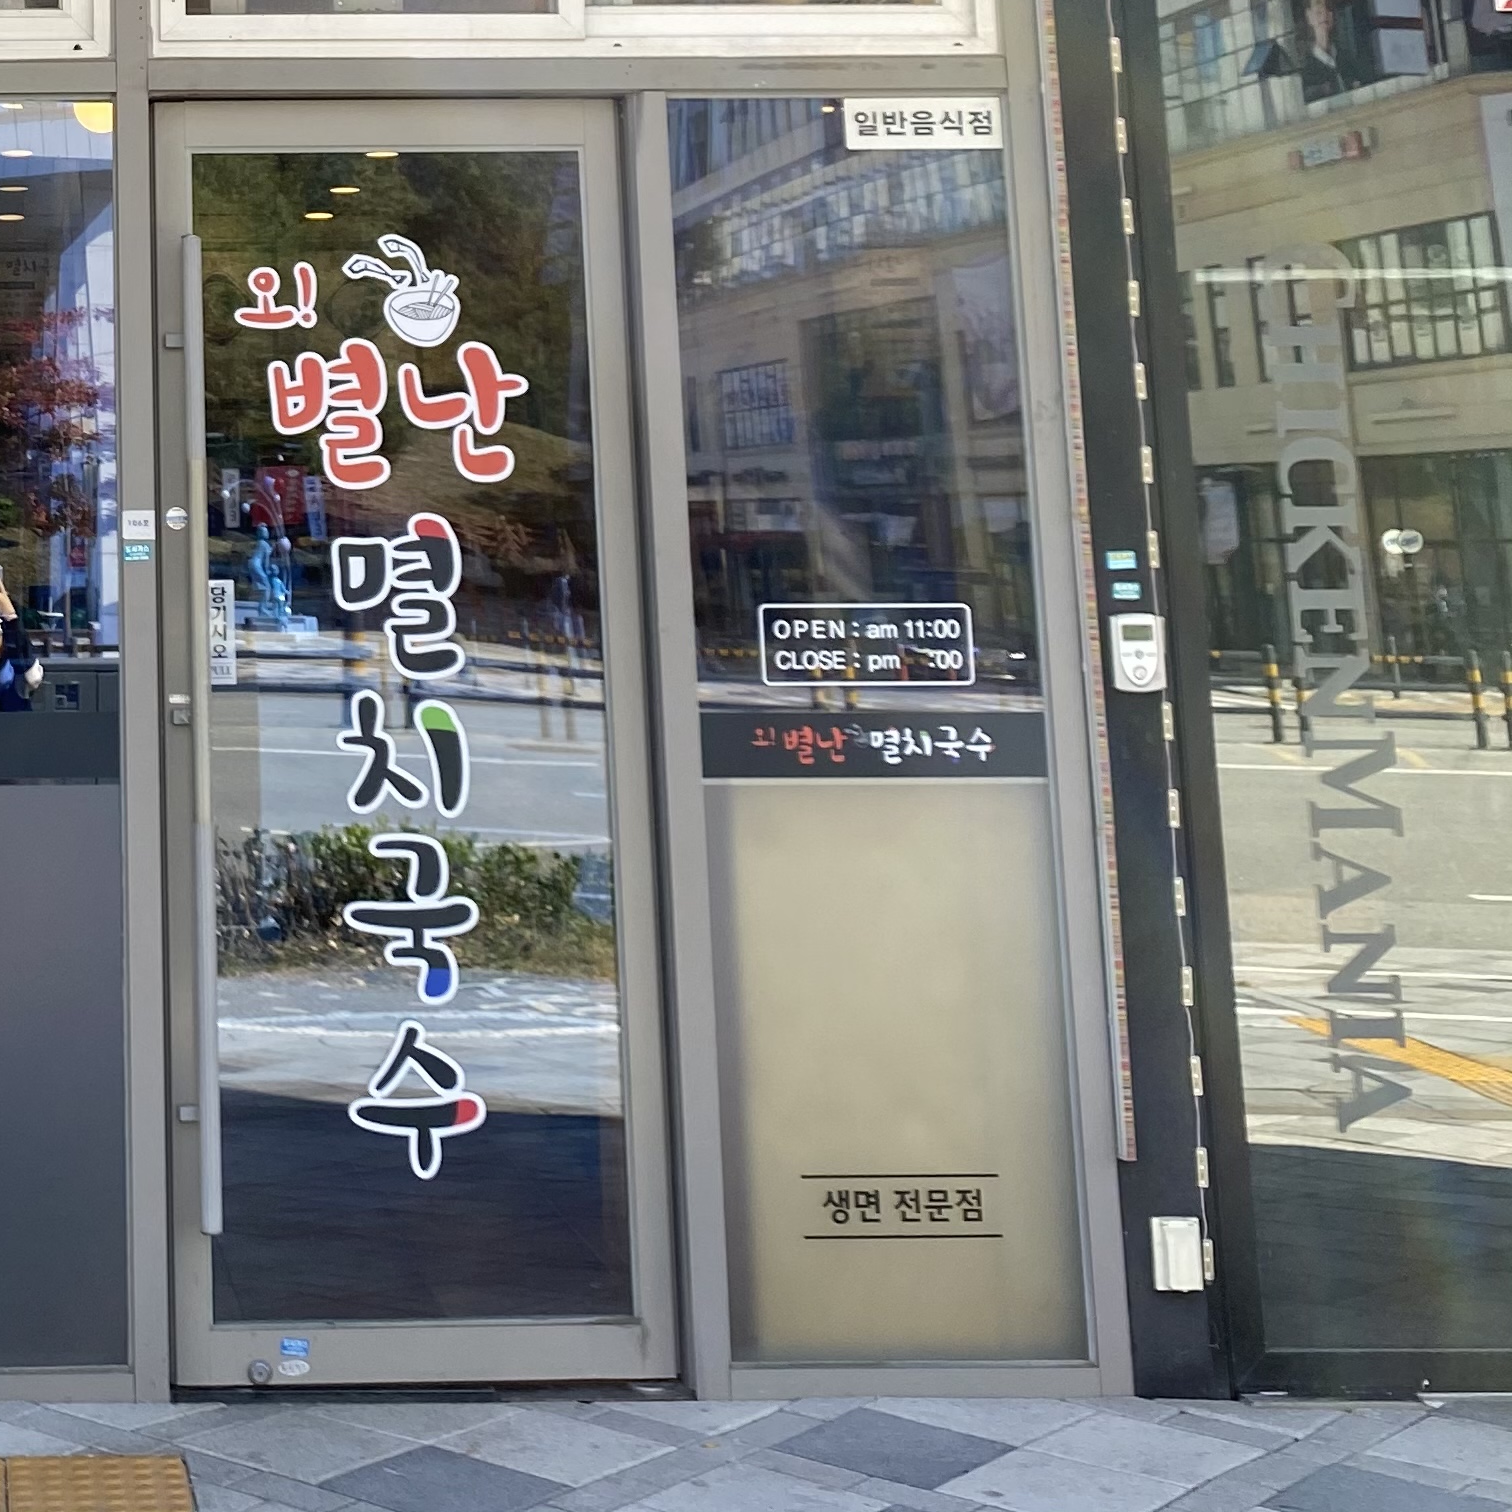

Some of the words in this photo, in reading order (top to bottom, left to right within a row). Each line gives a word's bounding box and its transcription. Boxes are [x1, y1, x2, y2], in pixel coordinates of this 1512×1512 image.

[854, 110, 993, 137] 일반음식점
[235, 261, 317, 329] 오!
[268, 338, 528, 490] 별난
[211, 586, 228, 659] 당기시오
[773, 619, 846, 639] OPEN
[866, 622, 899, 639] am
[904, 619, 961, 639] 11:00
[774, 650, 846, 671] CLOSE
[868, 653, 900, 673] pm
[784, 725, 848, 765] 별난
[870, 724, 996, 765] 멸치국수
[331, 512, 486, 1179] 멸치국수
[822, 1189, 882, 1224] 생면
[893, 1188, 984, 1223] 전문점
